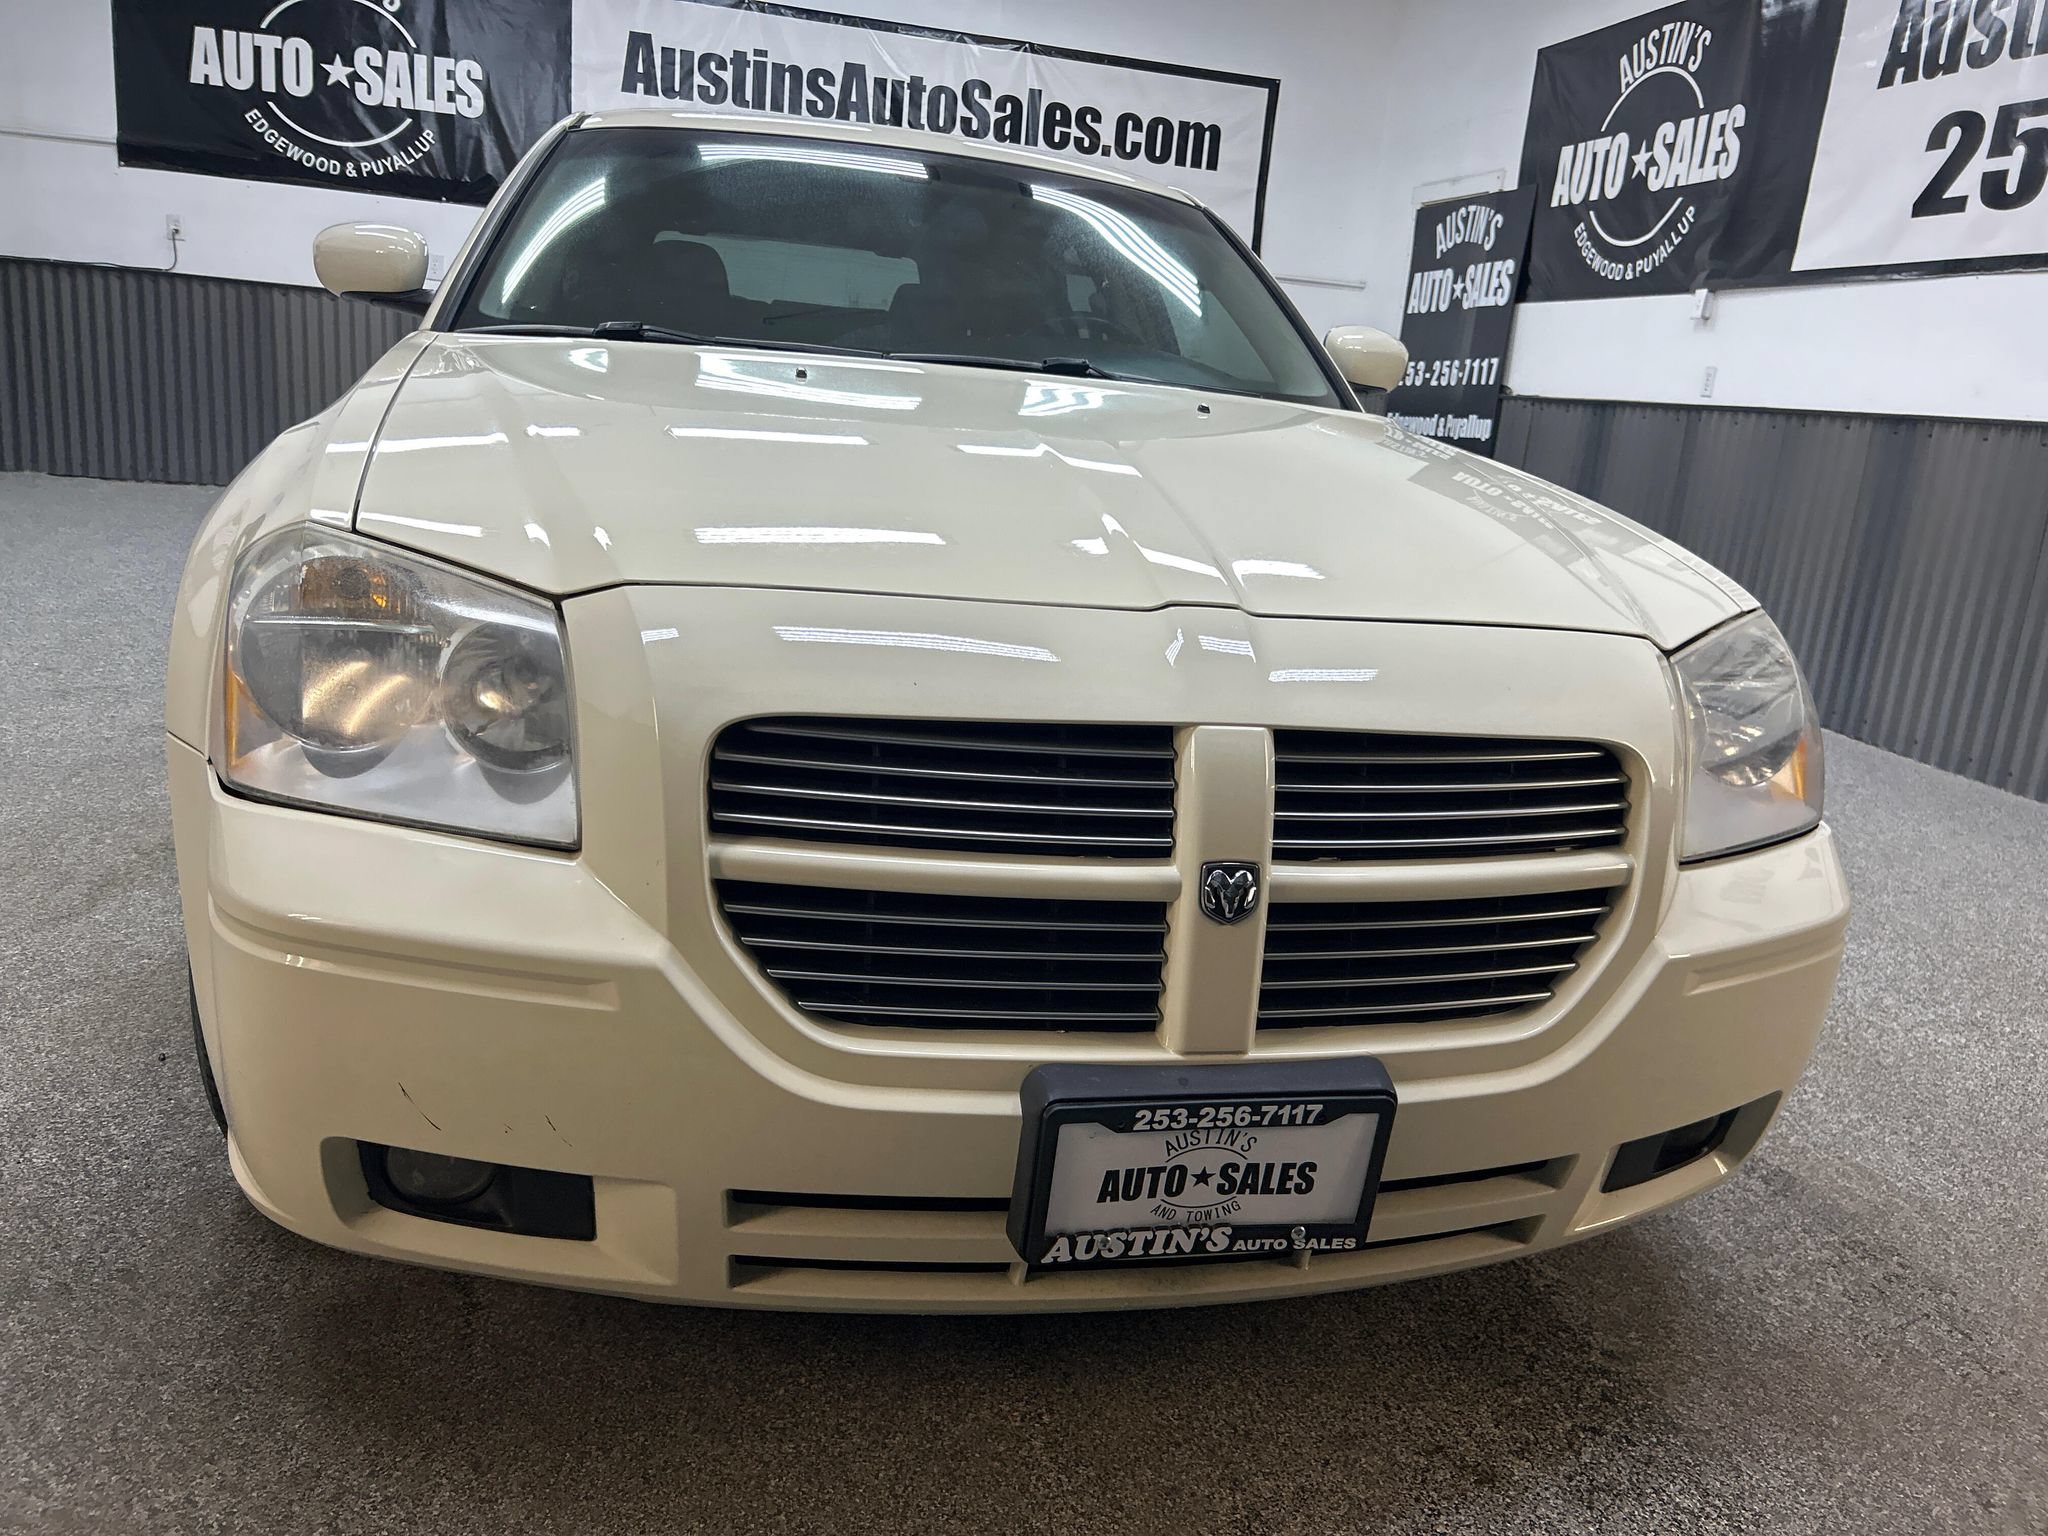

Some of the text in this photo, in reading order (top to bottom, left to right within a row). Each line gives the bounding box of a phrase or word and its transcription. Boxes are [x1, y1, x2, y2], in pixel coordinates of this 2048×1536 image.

[190, 25, 485, 119] AUTO SALES
[1619, 21, 1712, 93] AUSTIN'S
[620, 30, 1221, 172] AustinsAutoSales.com
[244, 108, 437, 178] EDGEWOOD & PUYALLUP
[1550, 103, 1746, 207] AUTO SALES
[1911, 98, 2048, 218] 25
[1436, 205, 1503, 259] AUSTIN'S
[1573, 205, 1697, 281] EDGEWOOD & PUYALLUP
[1407, 258, 1515, 314] AUTO SALES
[1398, 357, 1499, 386] 53-256-7117
[1437, 417, 1445, 437] &
[1445, 414, 1492, 441] Puyallup
[1133, 1104, 1324, 1131] 253-256-7117
[1164, 1128, 1257, 1157] AUSTIN'S
[1097, 1161, 1318, 1203] AUTO SALES
[1150, 1200, 1241, 1223] AND TOWING
[1041, 1225, 1356, 1263] AUSTIN'S AUTO SALES
